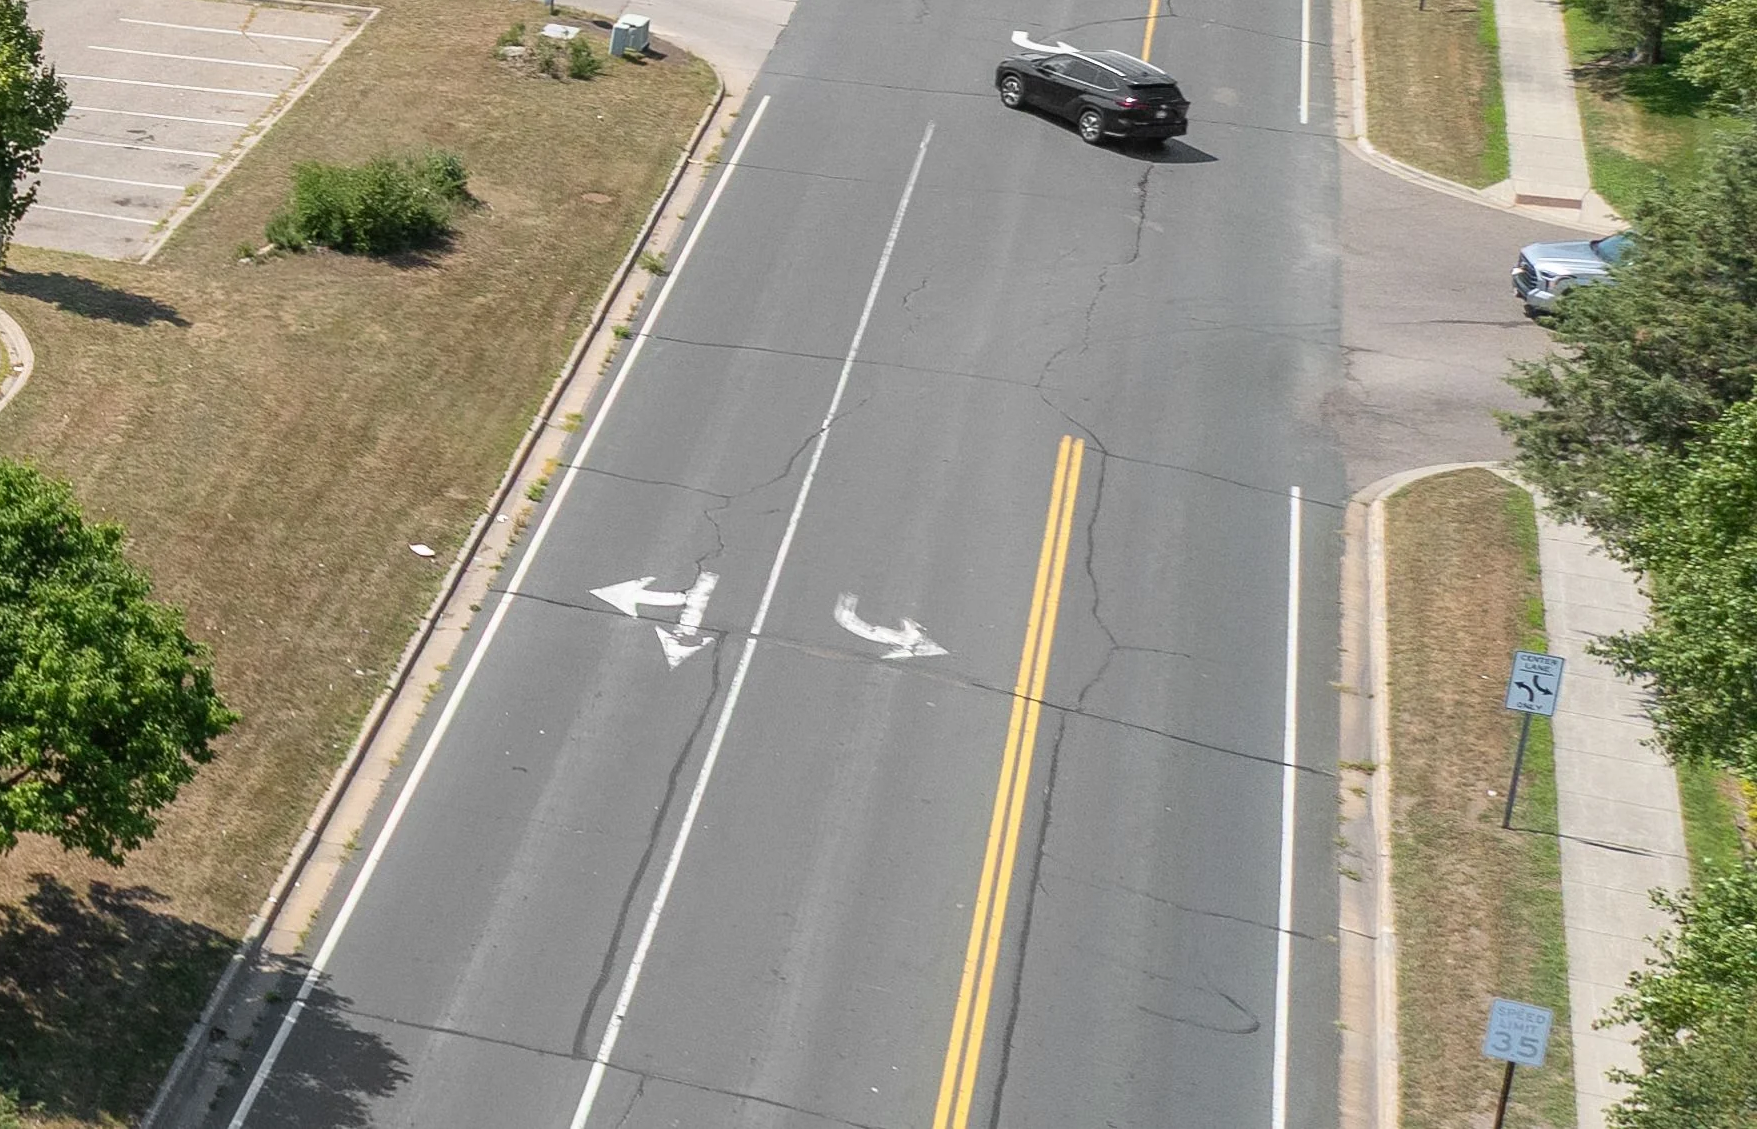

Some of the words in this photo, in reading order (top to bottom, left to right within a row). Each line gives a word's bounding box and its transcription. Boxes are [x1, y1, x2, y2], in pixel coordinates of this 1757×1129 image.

[1496, 1006, 1546, 1024] SPEED
[1498, 1018, 1537, 1034] LIMIT
[1491, 1031, 1539, 1058] 35
